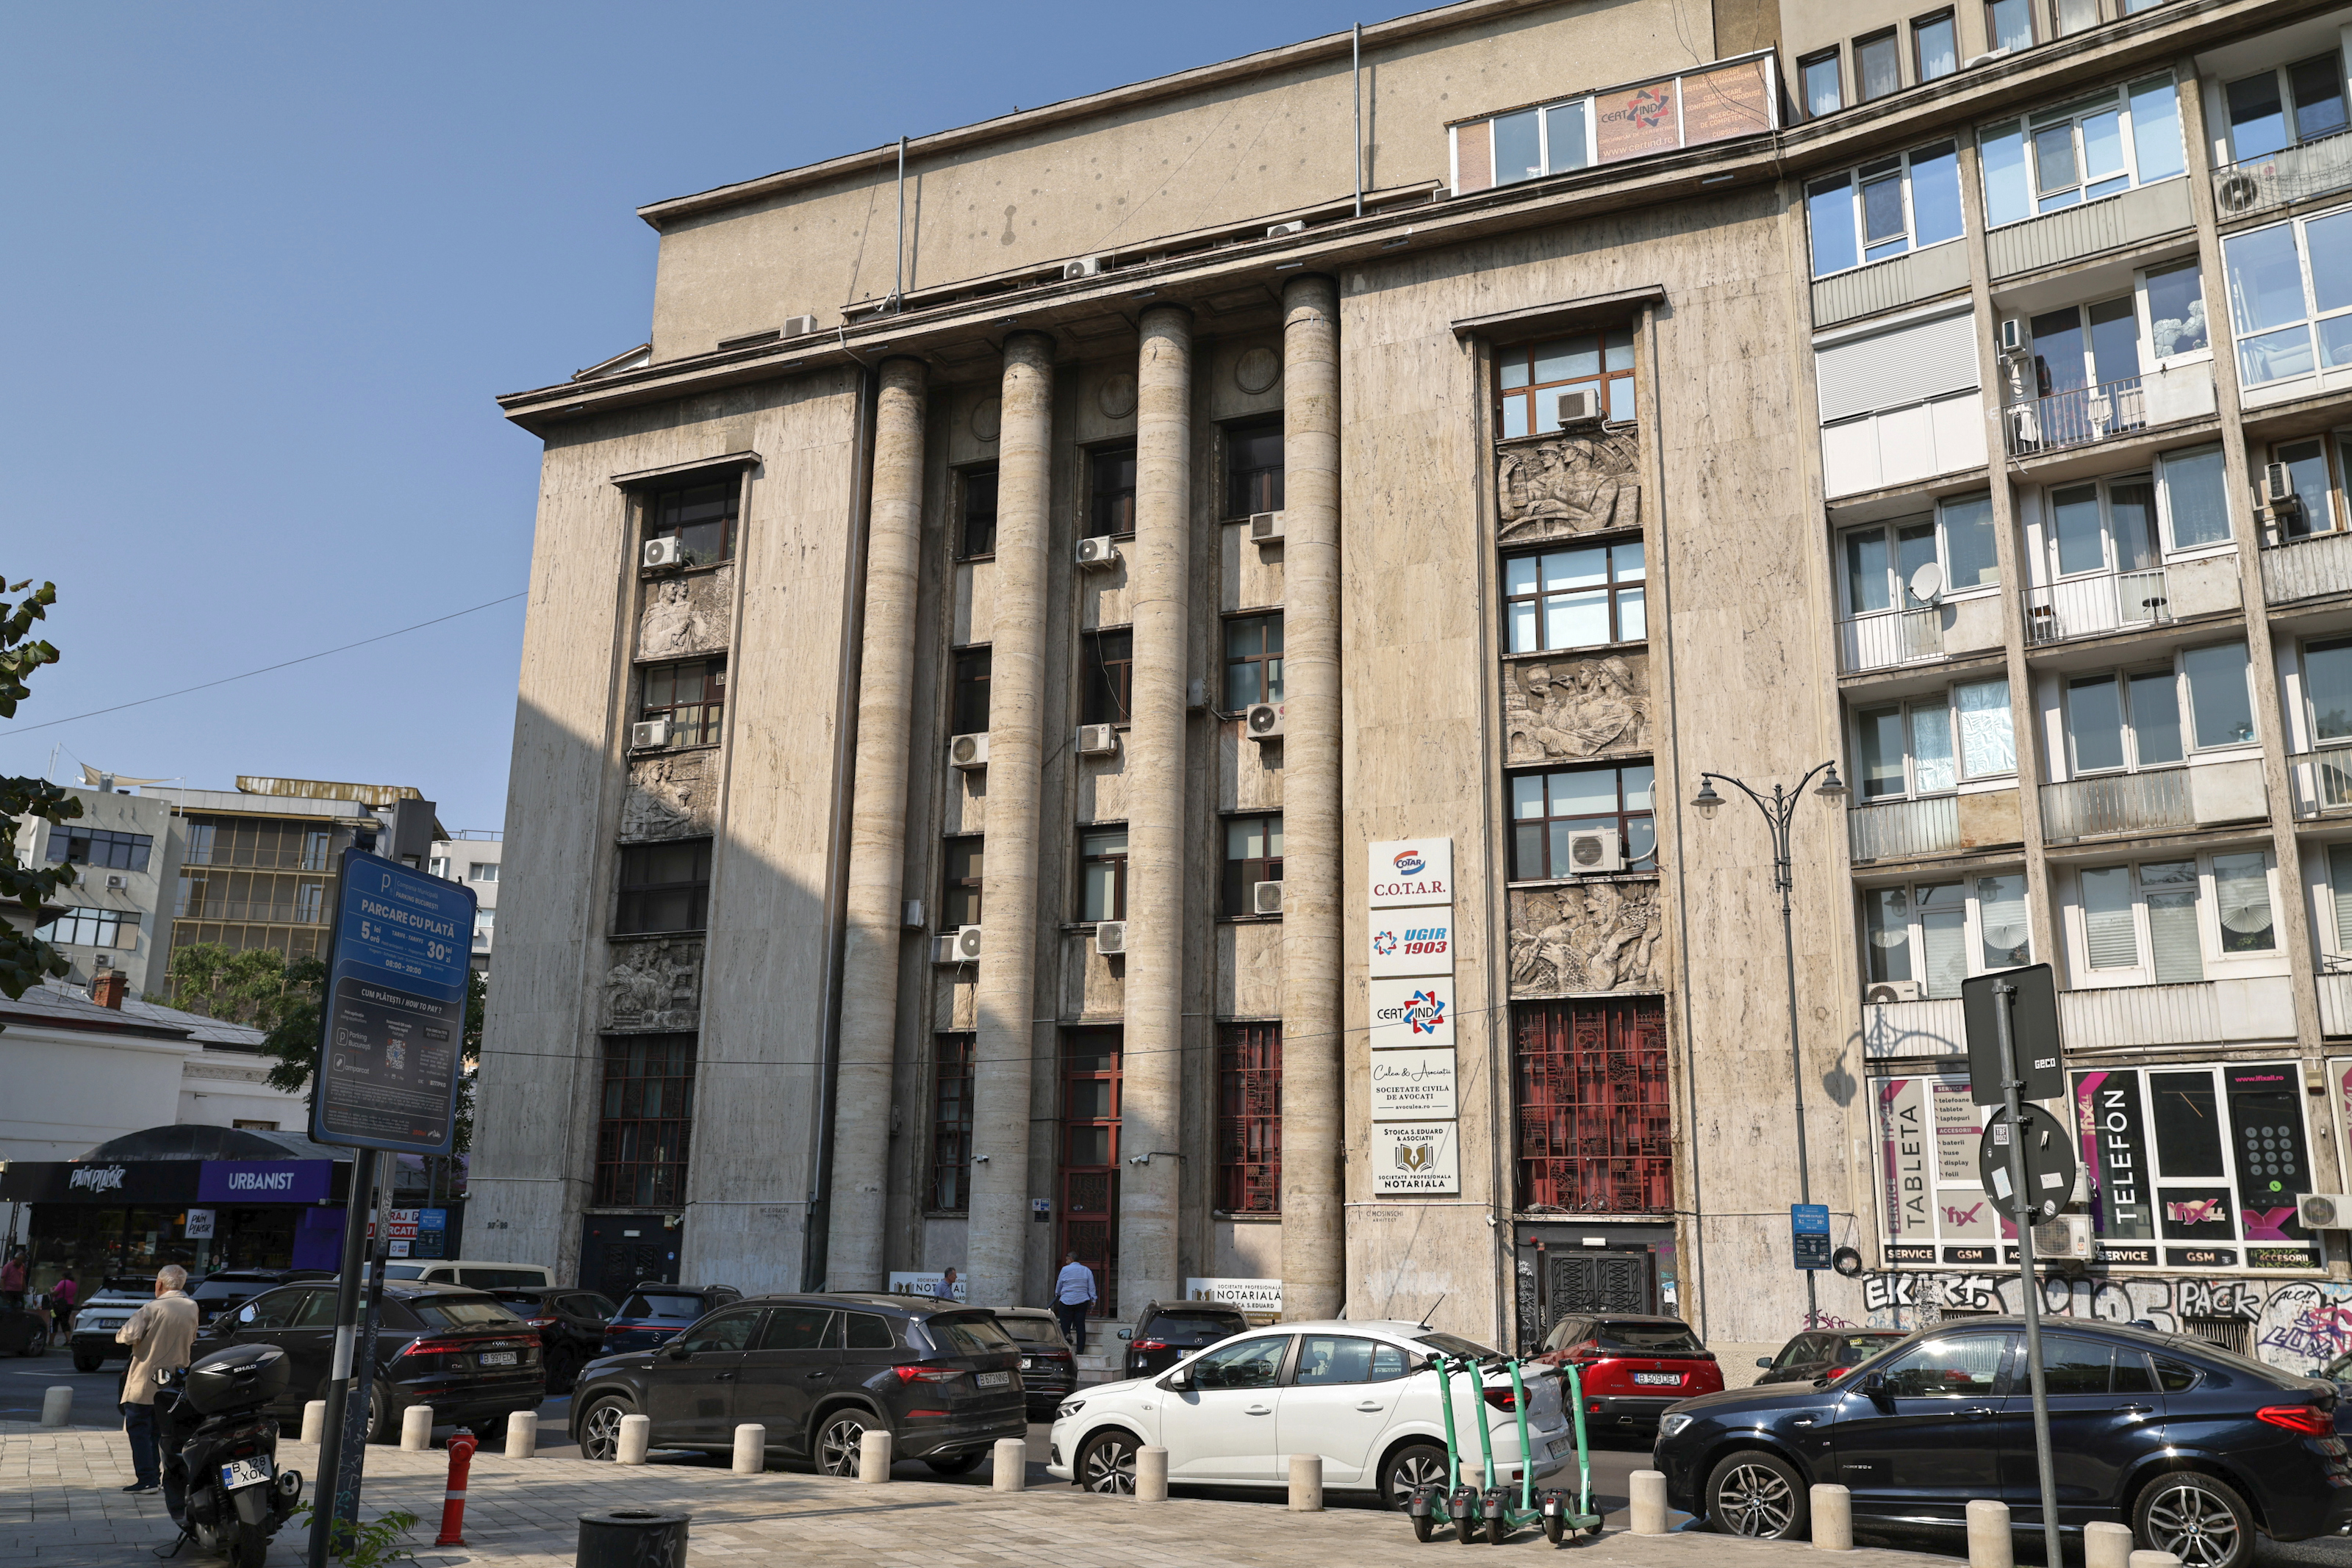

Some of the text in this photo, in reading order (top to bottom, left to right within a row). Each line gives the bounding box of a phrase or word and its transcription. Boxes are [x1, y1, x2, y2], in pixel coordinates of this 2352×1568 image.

[1682, 82, 1708, 93] SISTEME
[1703, 87, 1743, 101] CERTIFICARE
[1732, 89, 1761, 100] PRODUSE
[1602, 103, 1657, 123] CERT IND
[1599, 132, 1631, 145] ORGANISM
[1713, 127, 1740, 138] CURSURI
[1603, 136, 1674, 157] www.certind.ro
[397, 881, 417, 892] Compania
[1374, 881, 1446, 896] C.O.T.A.R.
[395, 891, 415, 903] PARKING
[362, 899, 455, 938] PARCARE CU PLATĂ
[361, 921, 370, 939] 5
[1404, 928, 1447, 941] UGIR
[392, 930, 424, 944] TARIFE TARIFFS
[427, 941, 445, 960] 30
[1404, 941, 1447, 954] 1903
[386, 960, 421, 974] 08:00 20:00
[362, 988, 375, 999] CUM
[376, 993, 401, 1005] PLĂTEȘTI
[405, 999, 419, 1009] HOW
[420, 1002, 426, 1010] TO
[427, 1004, 438, 1013] PAY
[1377, 1007, 1434, 1019] CERT IND
[349, 1031, 368, 1042] Parking
[345, 1065, 370, 1075] amparcat
[1374, 1065, 1399, 1080] Culea
[1402, 1068, 1410, 1076] &
[1940, 1115, 1970, 1123] laptopuri
[2104, 1090, 2137, 1224] TELEFON
[1899, 1104, 1926, 1229] TABLETA
[228, 1173, 294, 1190] URBANIST
[1385, 1180, 1445, 1188] NOTARIALA
[1889, 1177, 1899, 1230] SERVICE
[1887, 1249, 1933, 1259] SERVICE
[1957, 1249, 1982, 1259] GSM
[2097, 1251, 2148, 1262] SERVICE
[2187, 1252, 2215, 1262] GSM
[484, 1353, 516, 1363] B 997 EDN
[234, 1364, 257, 1373] SHAD
[980, 1373, 1008, 1384] B 673 NNG
[232, 1456, 266, 1473] B 128
[240, 1467, 267, 1482] XOK
